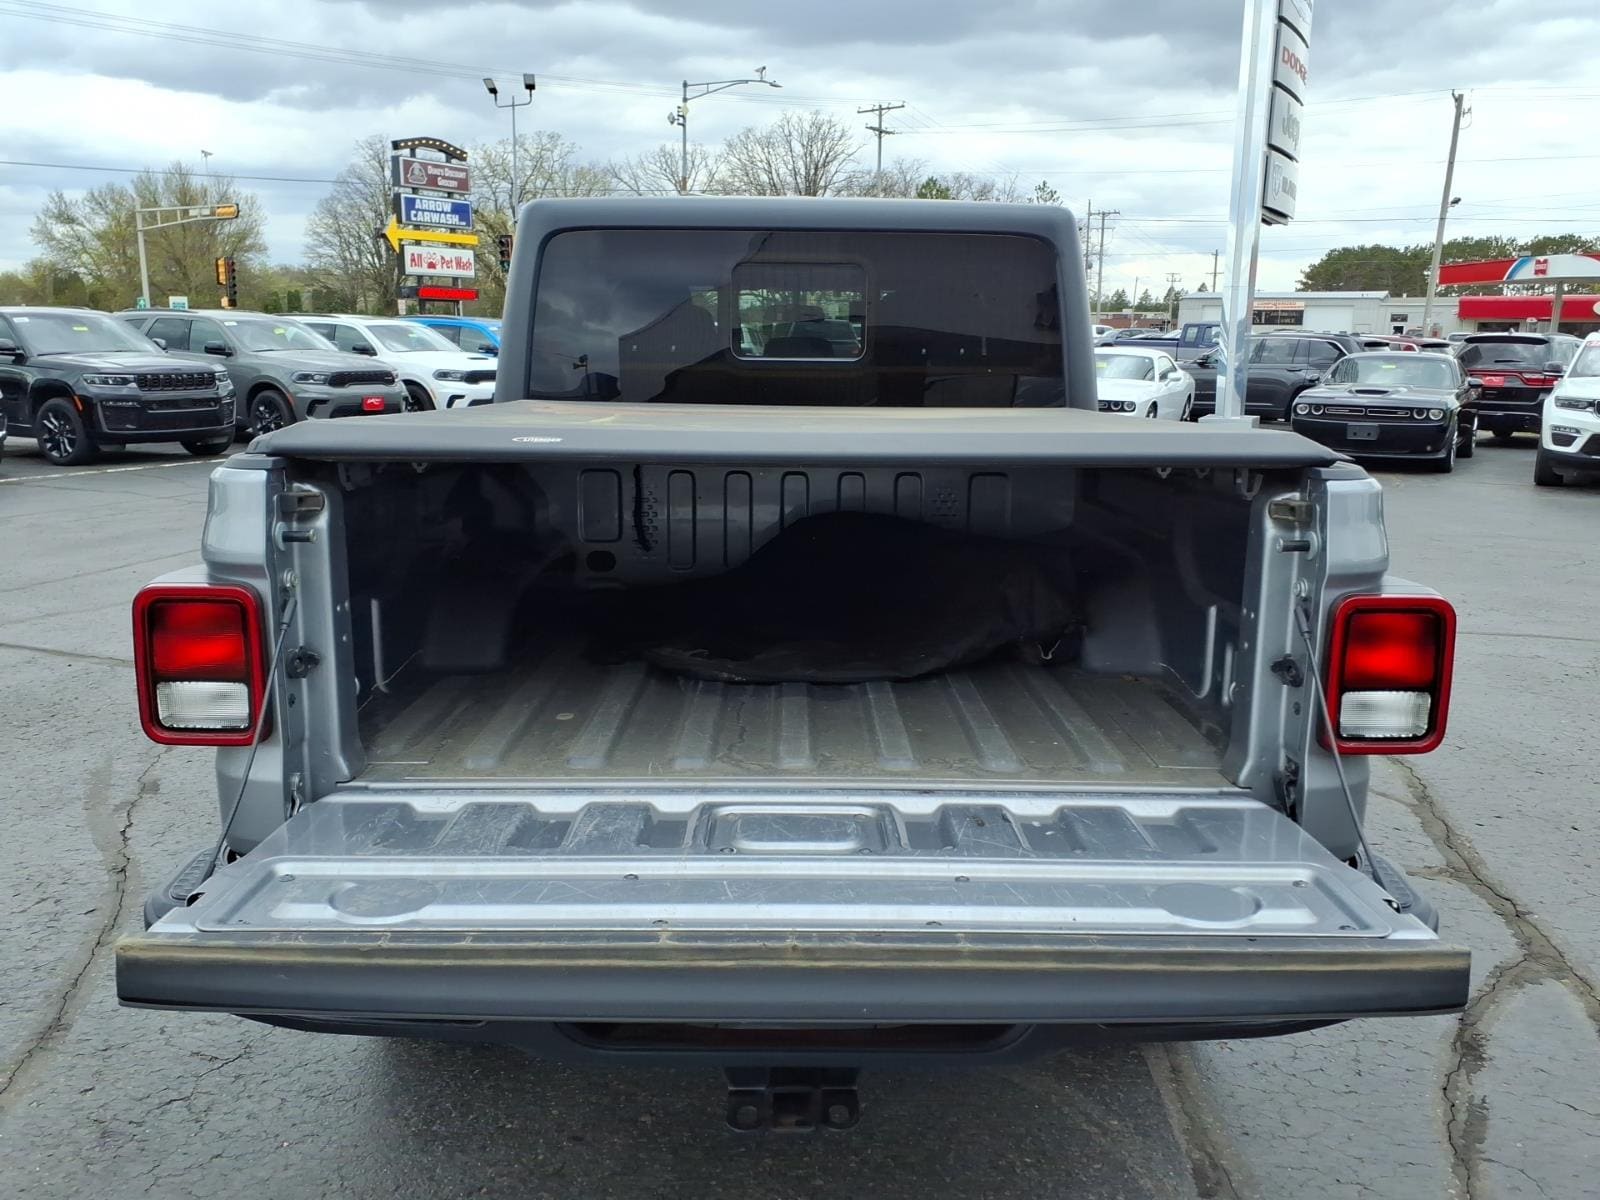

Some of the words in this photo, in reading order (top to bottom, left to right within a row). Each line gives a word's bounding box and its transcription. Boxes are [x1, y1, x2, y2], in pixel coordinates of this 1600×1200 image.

[1282, 46, 1308, 81] DODGE
[415, 198, 452, 213] ARROW
[410, 210, 460, 225] CARWASH
[410, 253, 423, 268] All
[440, 255, 453, 270] Pet
[454, 256, 473, 272] Wash
